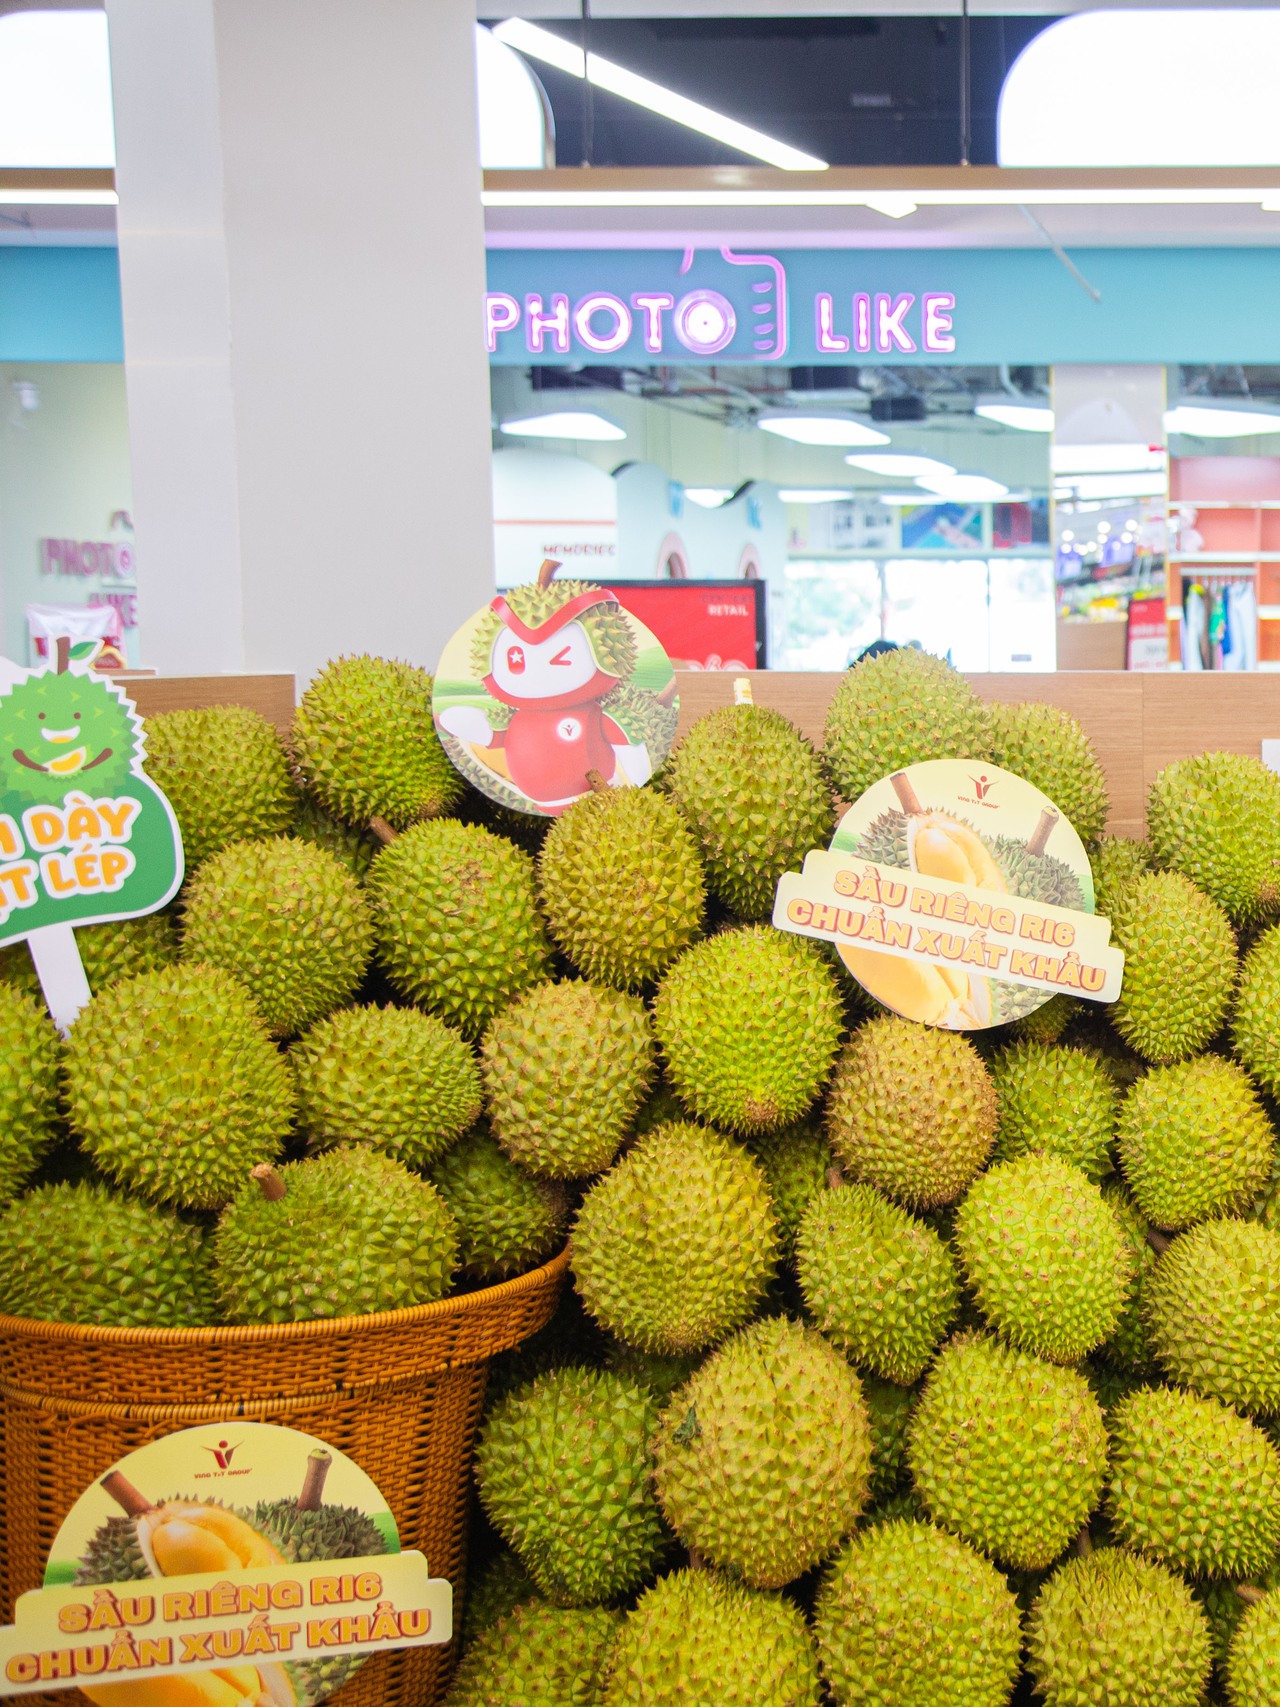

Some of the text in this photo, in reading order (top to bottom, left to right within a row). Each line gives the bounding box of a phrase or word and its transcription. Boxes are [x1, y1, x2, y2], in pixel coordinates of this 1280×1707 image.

[484, 289, 956, 354] PHOTO LIKE
[708, 604, 749, 616] RETAIL
[30, 797, 134, 846] DÀY
[47, 843, 129, 892] LÉP
[833, 865, 1076, 947] SẦU RIÊNG RI6
[786, 899, 1108, 993] CHUẨN XUẤT KHẨU
[58, 1571, 384, 1634] SẦU RIÊNG RI6
[5, 1601, 431, 1685] CHUẨN XUẤT KHẨU
